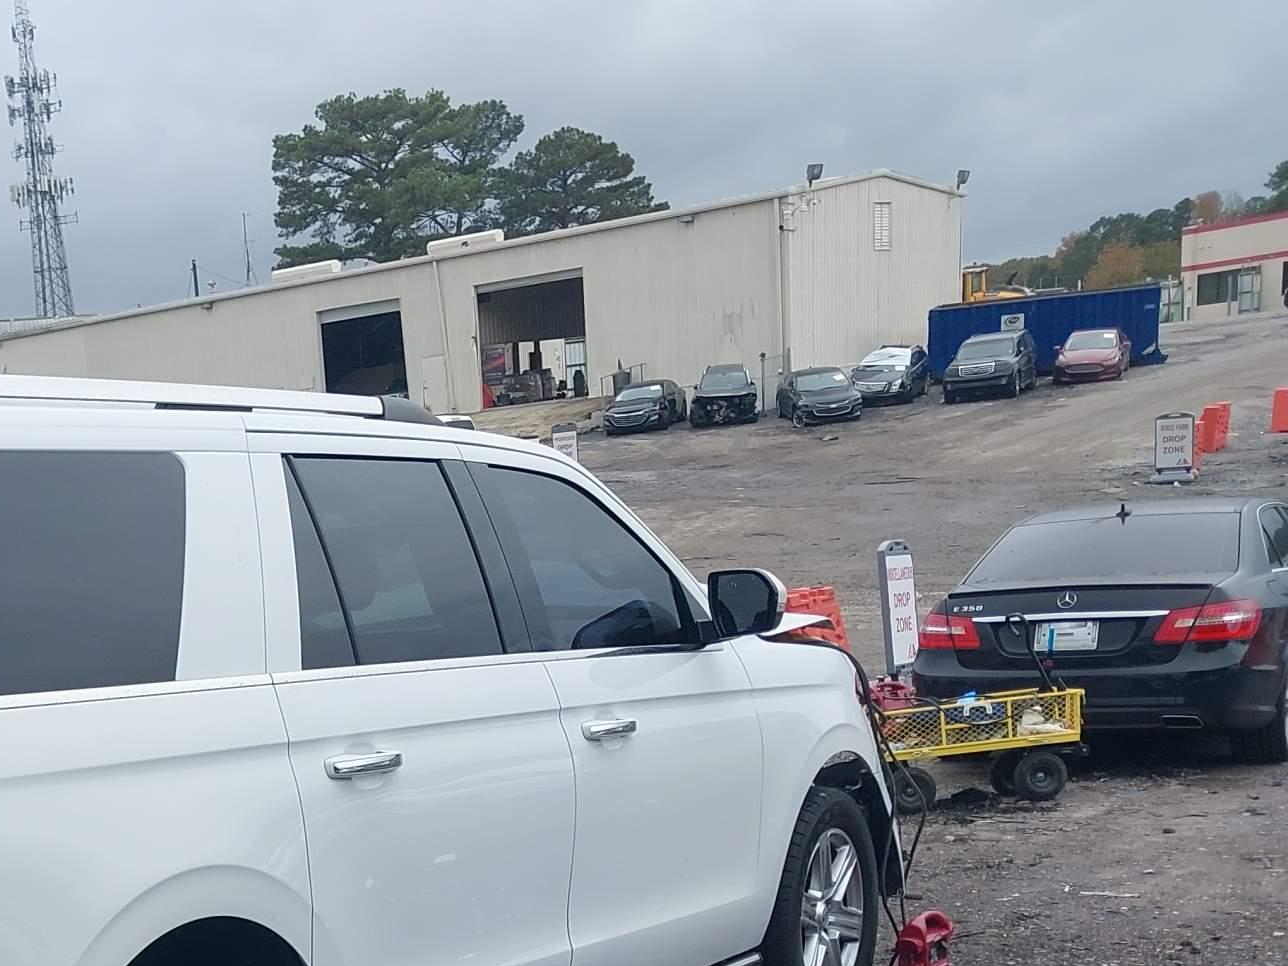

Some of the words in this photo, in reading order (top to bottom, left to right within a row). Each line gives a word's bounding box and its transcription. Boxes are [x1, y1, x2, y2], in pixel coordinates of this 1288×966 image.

[1162, 435, 1186, 443] DROP
[1162, 446, 1186, 454] ZONE
[893, 592, 911, 608] DROP
[896, 616, 912, 632] ZONE
